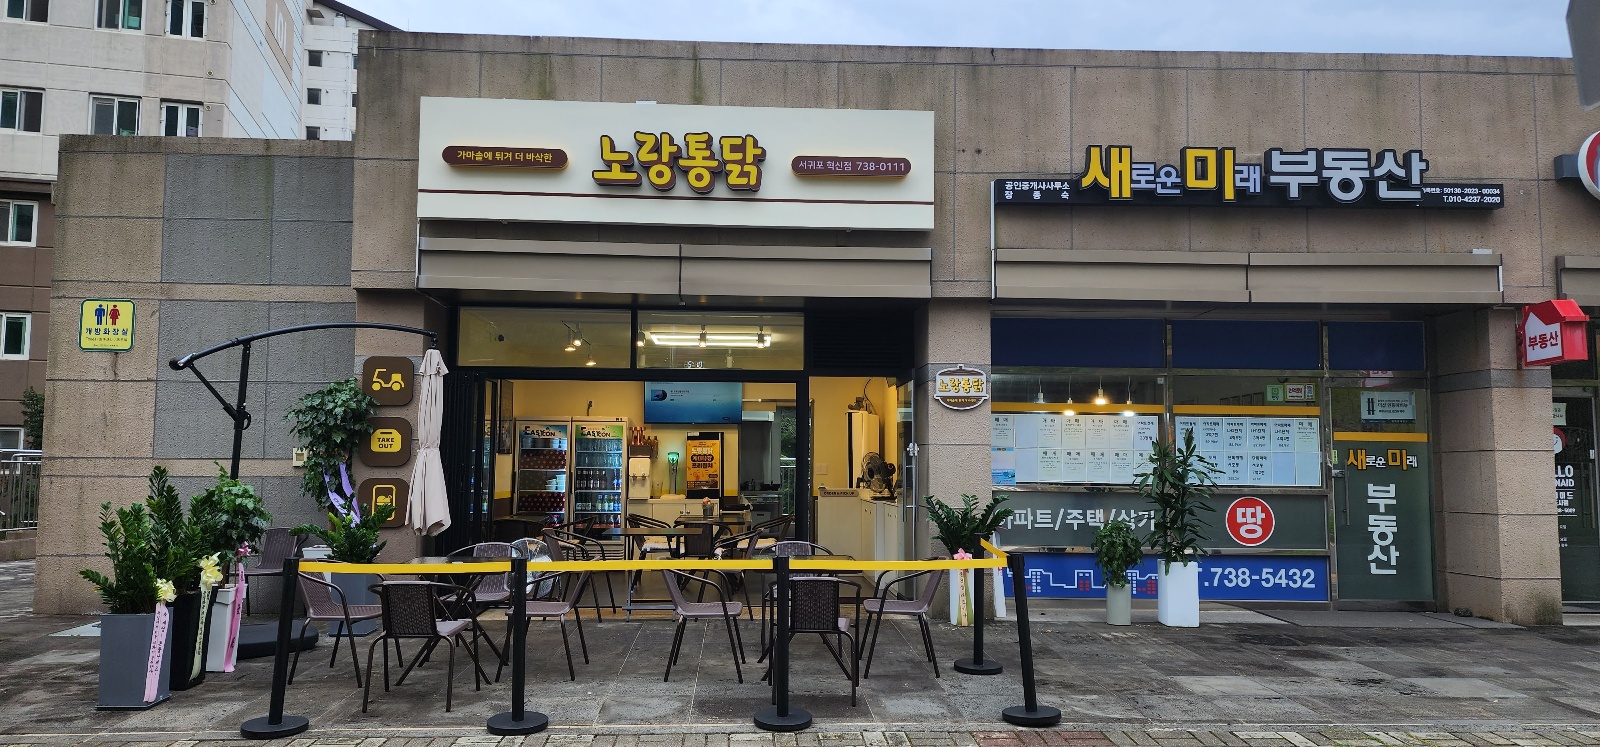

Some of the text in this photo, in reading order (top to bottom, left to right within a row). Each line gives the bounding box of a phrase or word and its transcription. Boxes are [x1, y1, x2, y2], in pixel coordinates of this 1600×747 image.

[457, 150, 492, 161] 가마솥에
[515, 153, 523, 162] 더
[526, 153, 553, 163] 바삭한
[592, 131, 766, 193] 노랑통닭
[799, 160, 905, 171] 서귀포 혁신점 738-0111
[1269, 150, 1427, 201] 부동산
[1005, 181, 1071, 190] 공인중개사사무소
[1443, 195, 1500, 203] T.010-4237-2020
[86, 328, 129, 336] 개방화장실
[1528, 331, 1559, 351] 부동산
[938, 377, 984, 393] 노랑통닭
[1555, 464, 1574, 477] LO
[1556, 491, 1574, 500] 이드
[1236, 505, 1266, 539] 땅
[1366, 483, 1400, 575] 부동산
